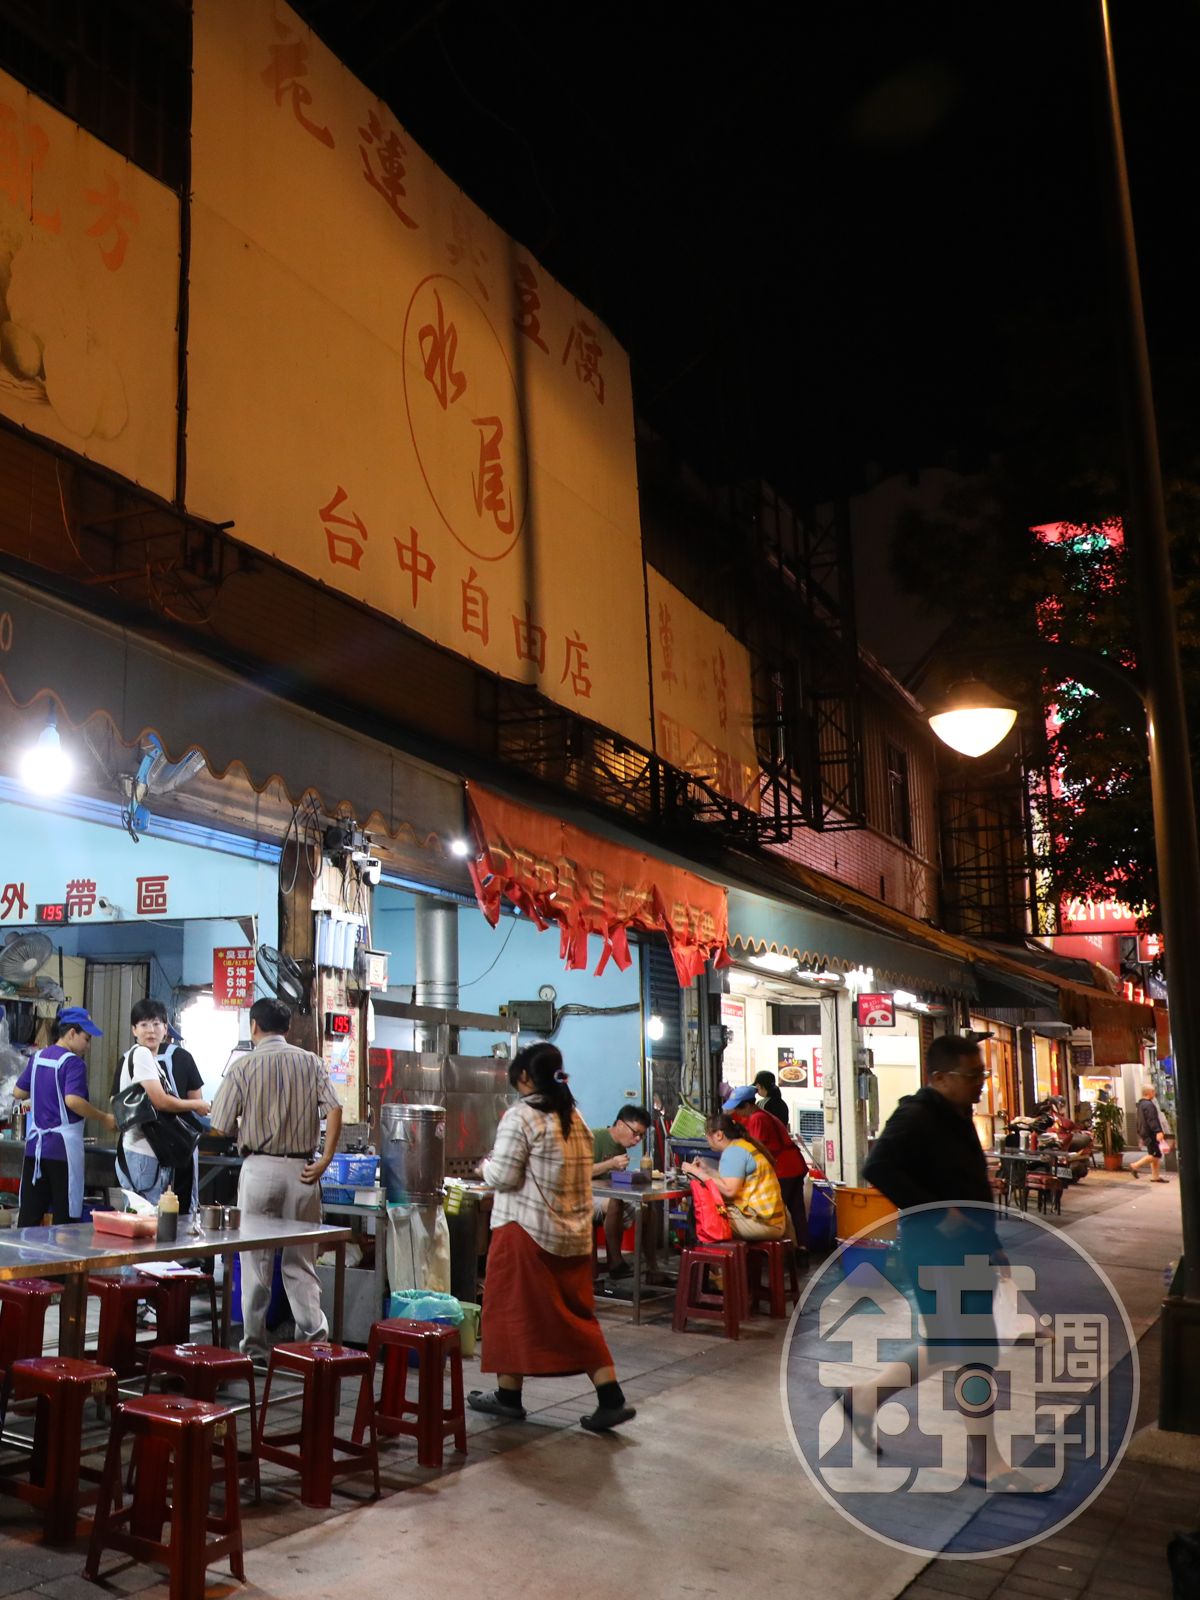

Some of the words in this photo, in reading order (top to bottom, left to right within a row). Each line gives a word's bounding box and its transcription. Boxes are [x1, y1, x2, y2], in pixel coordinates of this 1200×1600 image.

[319, 486, 593, 699] 台中自由店
[41, 905, 63, 921] 195
[334, 1016, 349, 1033] 195
